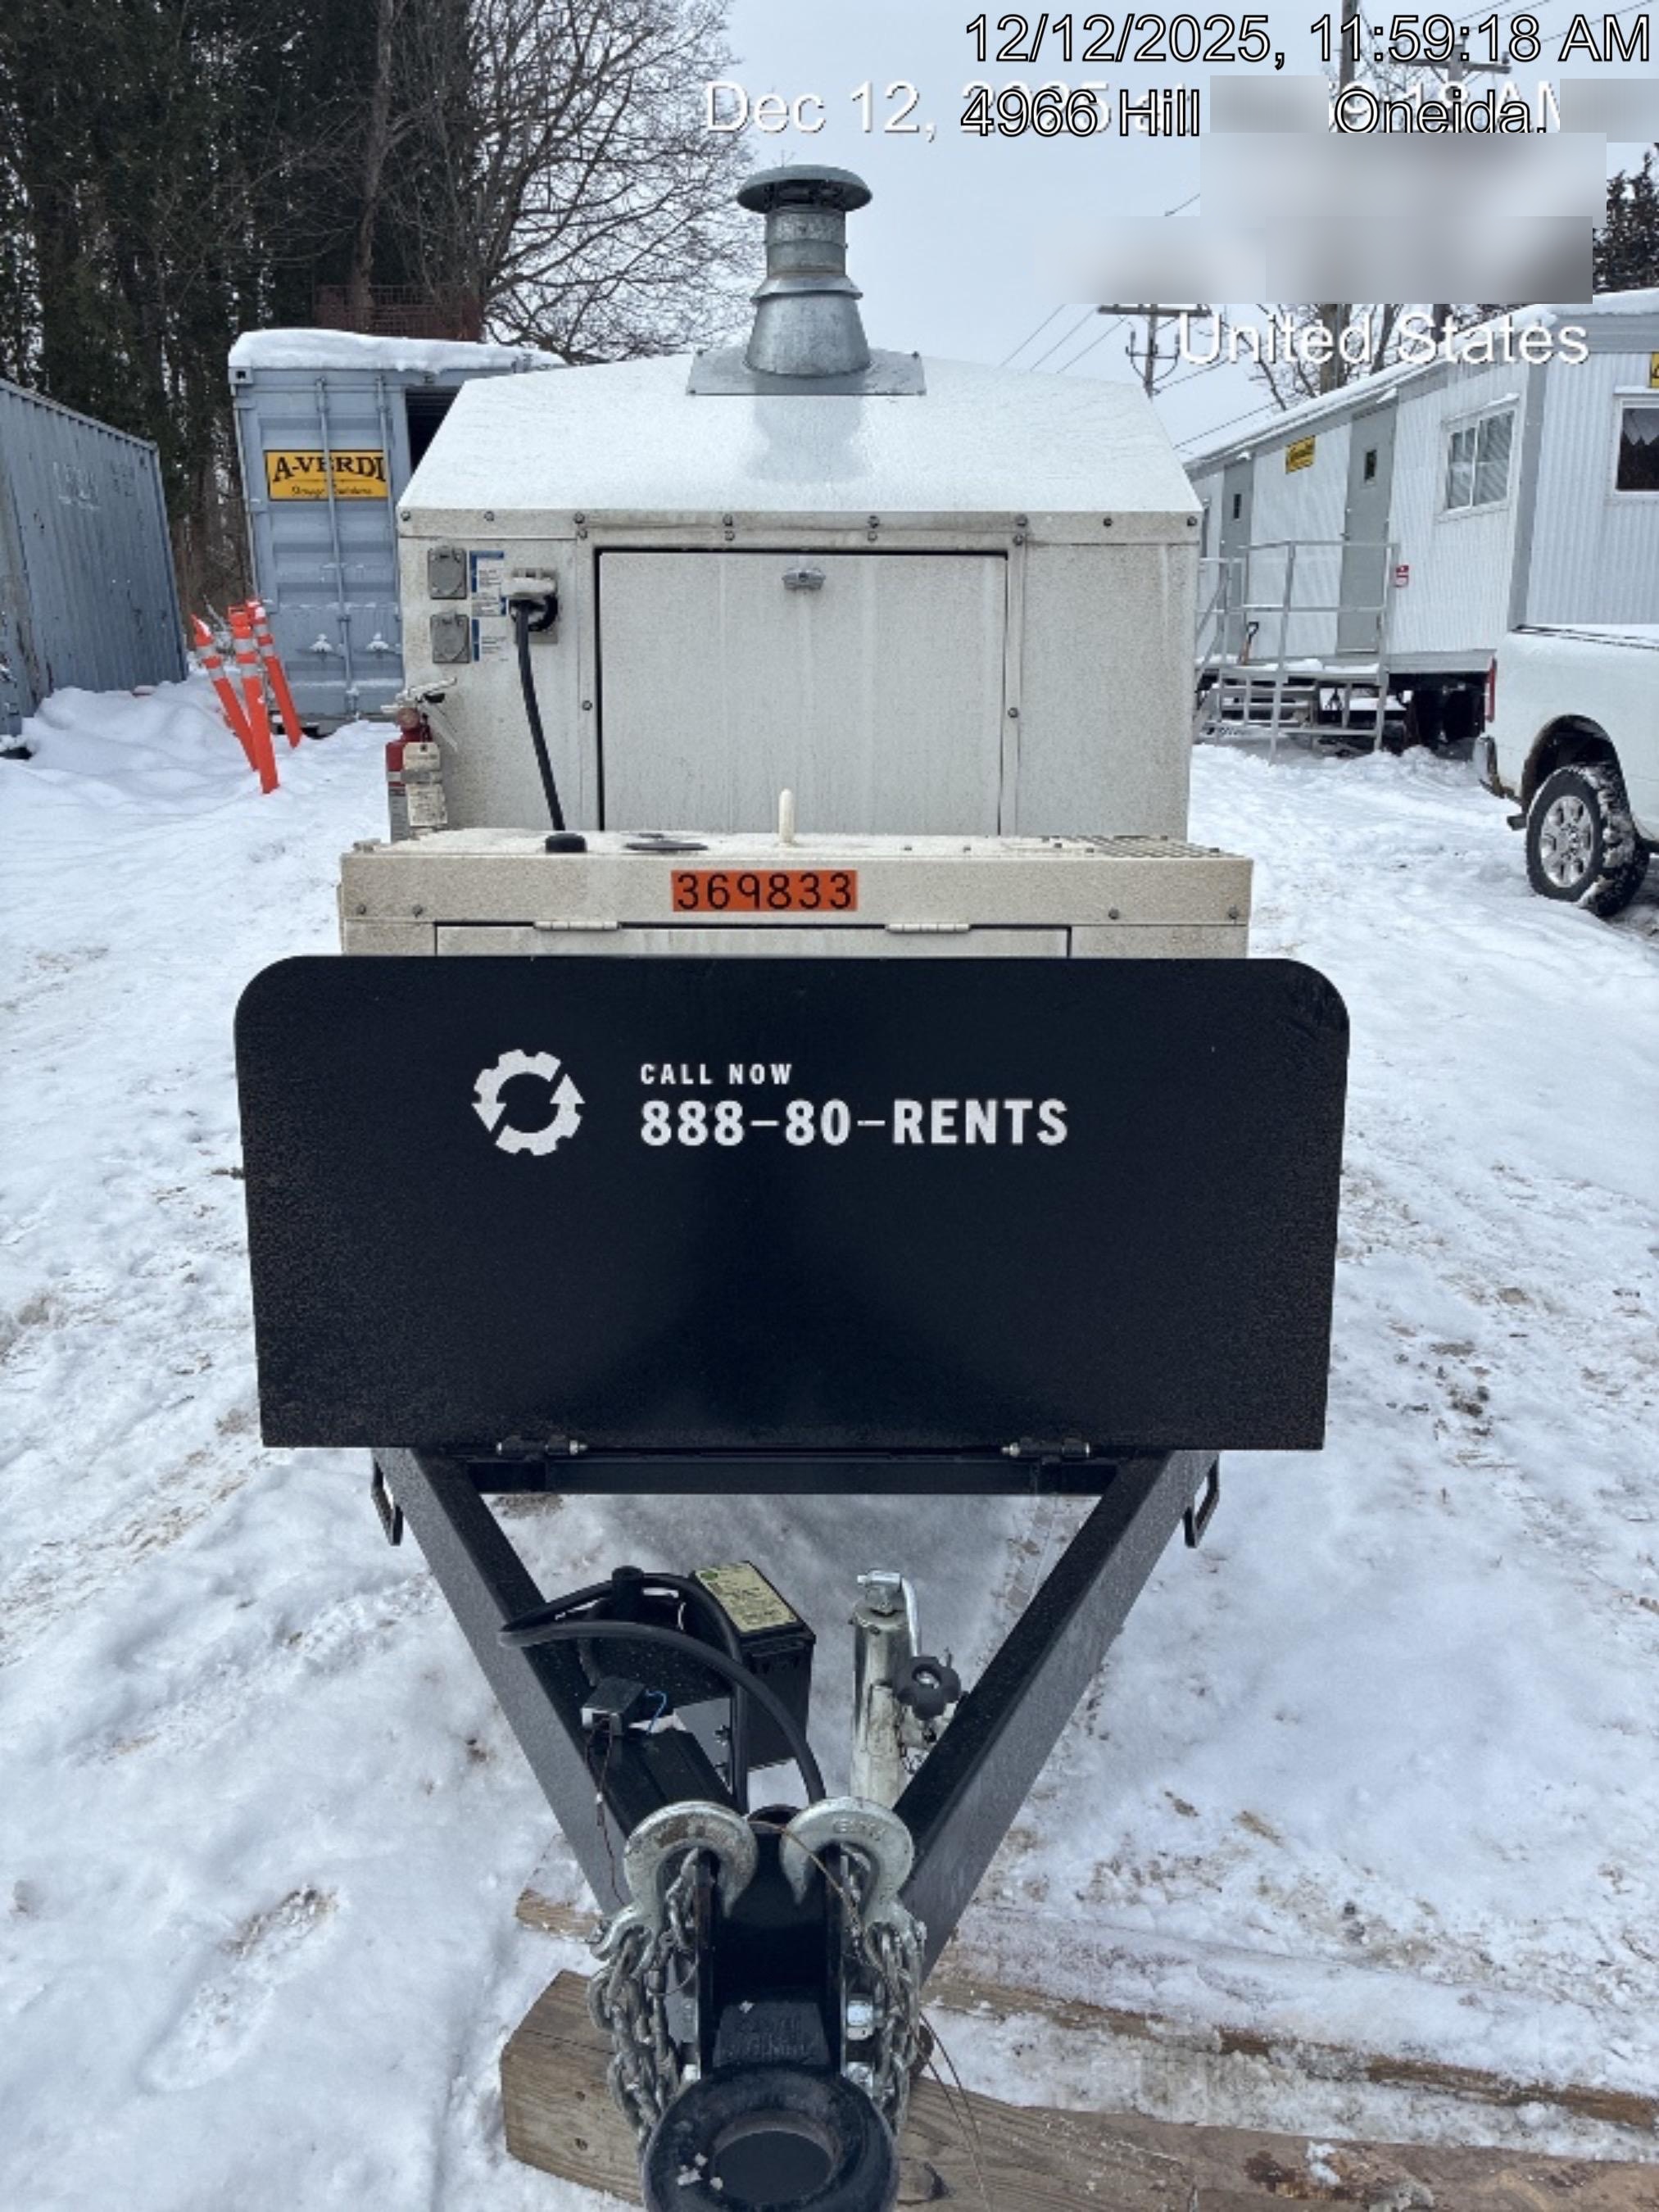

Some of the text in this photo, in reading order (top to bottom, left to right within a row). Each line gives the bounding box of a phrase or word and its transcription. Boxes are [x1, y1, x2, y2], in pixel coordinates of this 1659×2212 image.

[272, 456, 386, 483] A-VERDI
[678, 872, 851, 910] 369833
[641, 1063, 793, 1086] CALL NOW
[641, 1098, 1068, 1147] 888-80-RENTS
